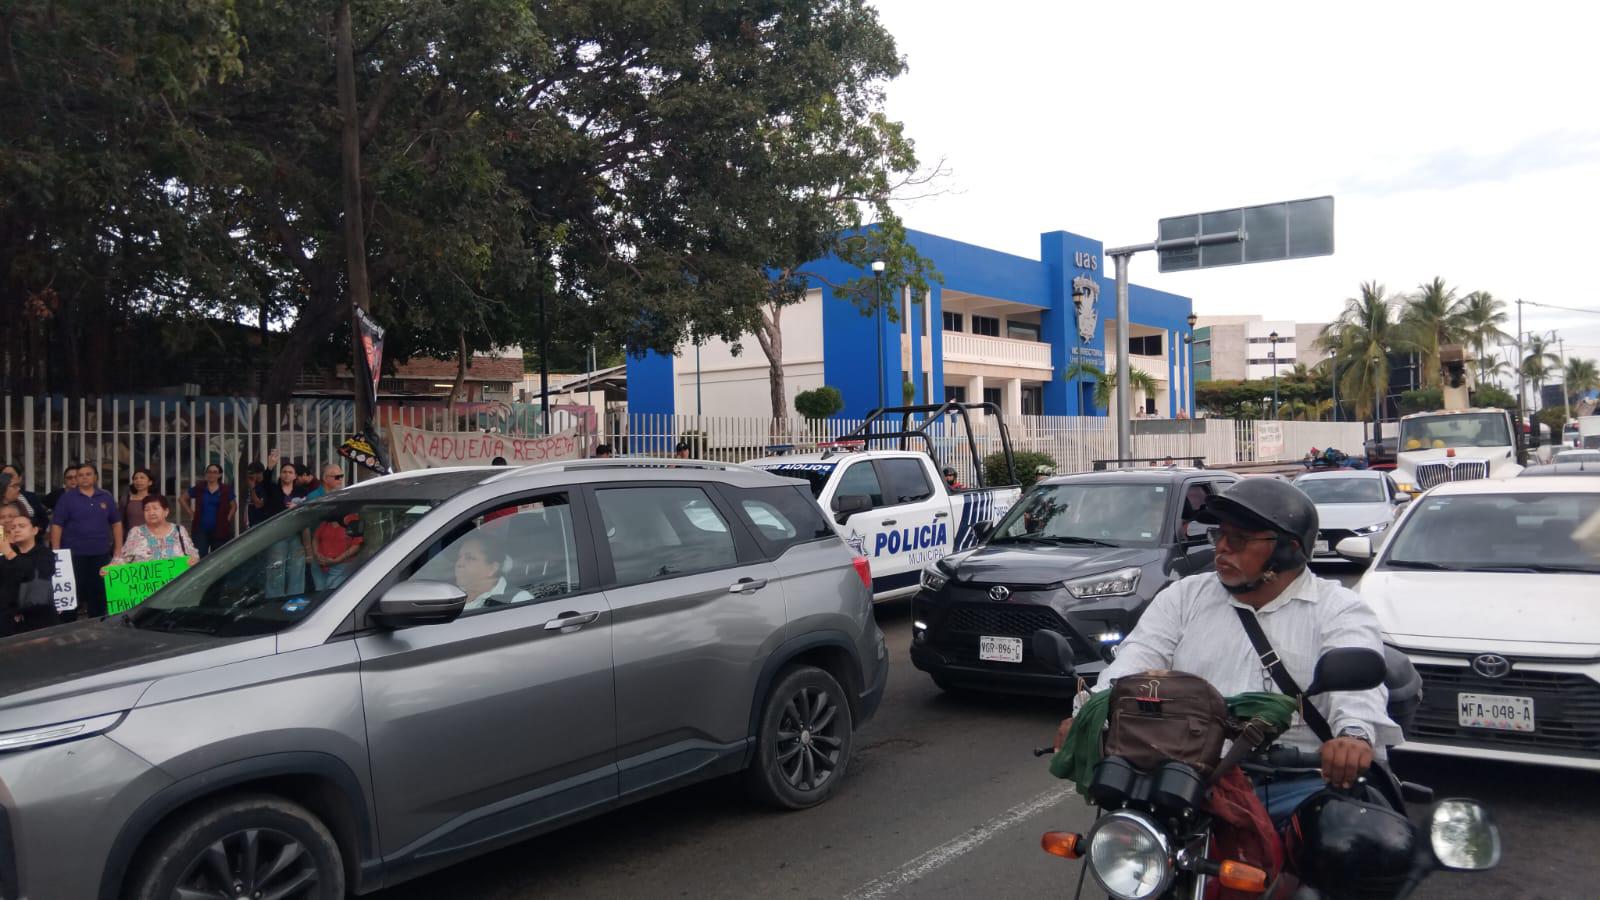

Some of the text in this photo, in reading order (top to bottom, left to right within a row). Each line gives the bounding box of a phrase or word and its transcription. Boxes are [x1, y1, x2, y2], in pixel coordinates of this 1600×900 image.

[1075, 251, 1098, 270] uas
[403, 432, 504, 461] MADUEÑA
[874, 518, 947, 557] POLICÍA
[108, 563, 163, 587] PORQUE
[53, 582, 72, 593] AS
[54, 597, 75, 608] ES!
[981, 642, 1020, 655] VGR-896-C
[1461, 702, 1531, 720] MFA-048-A
